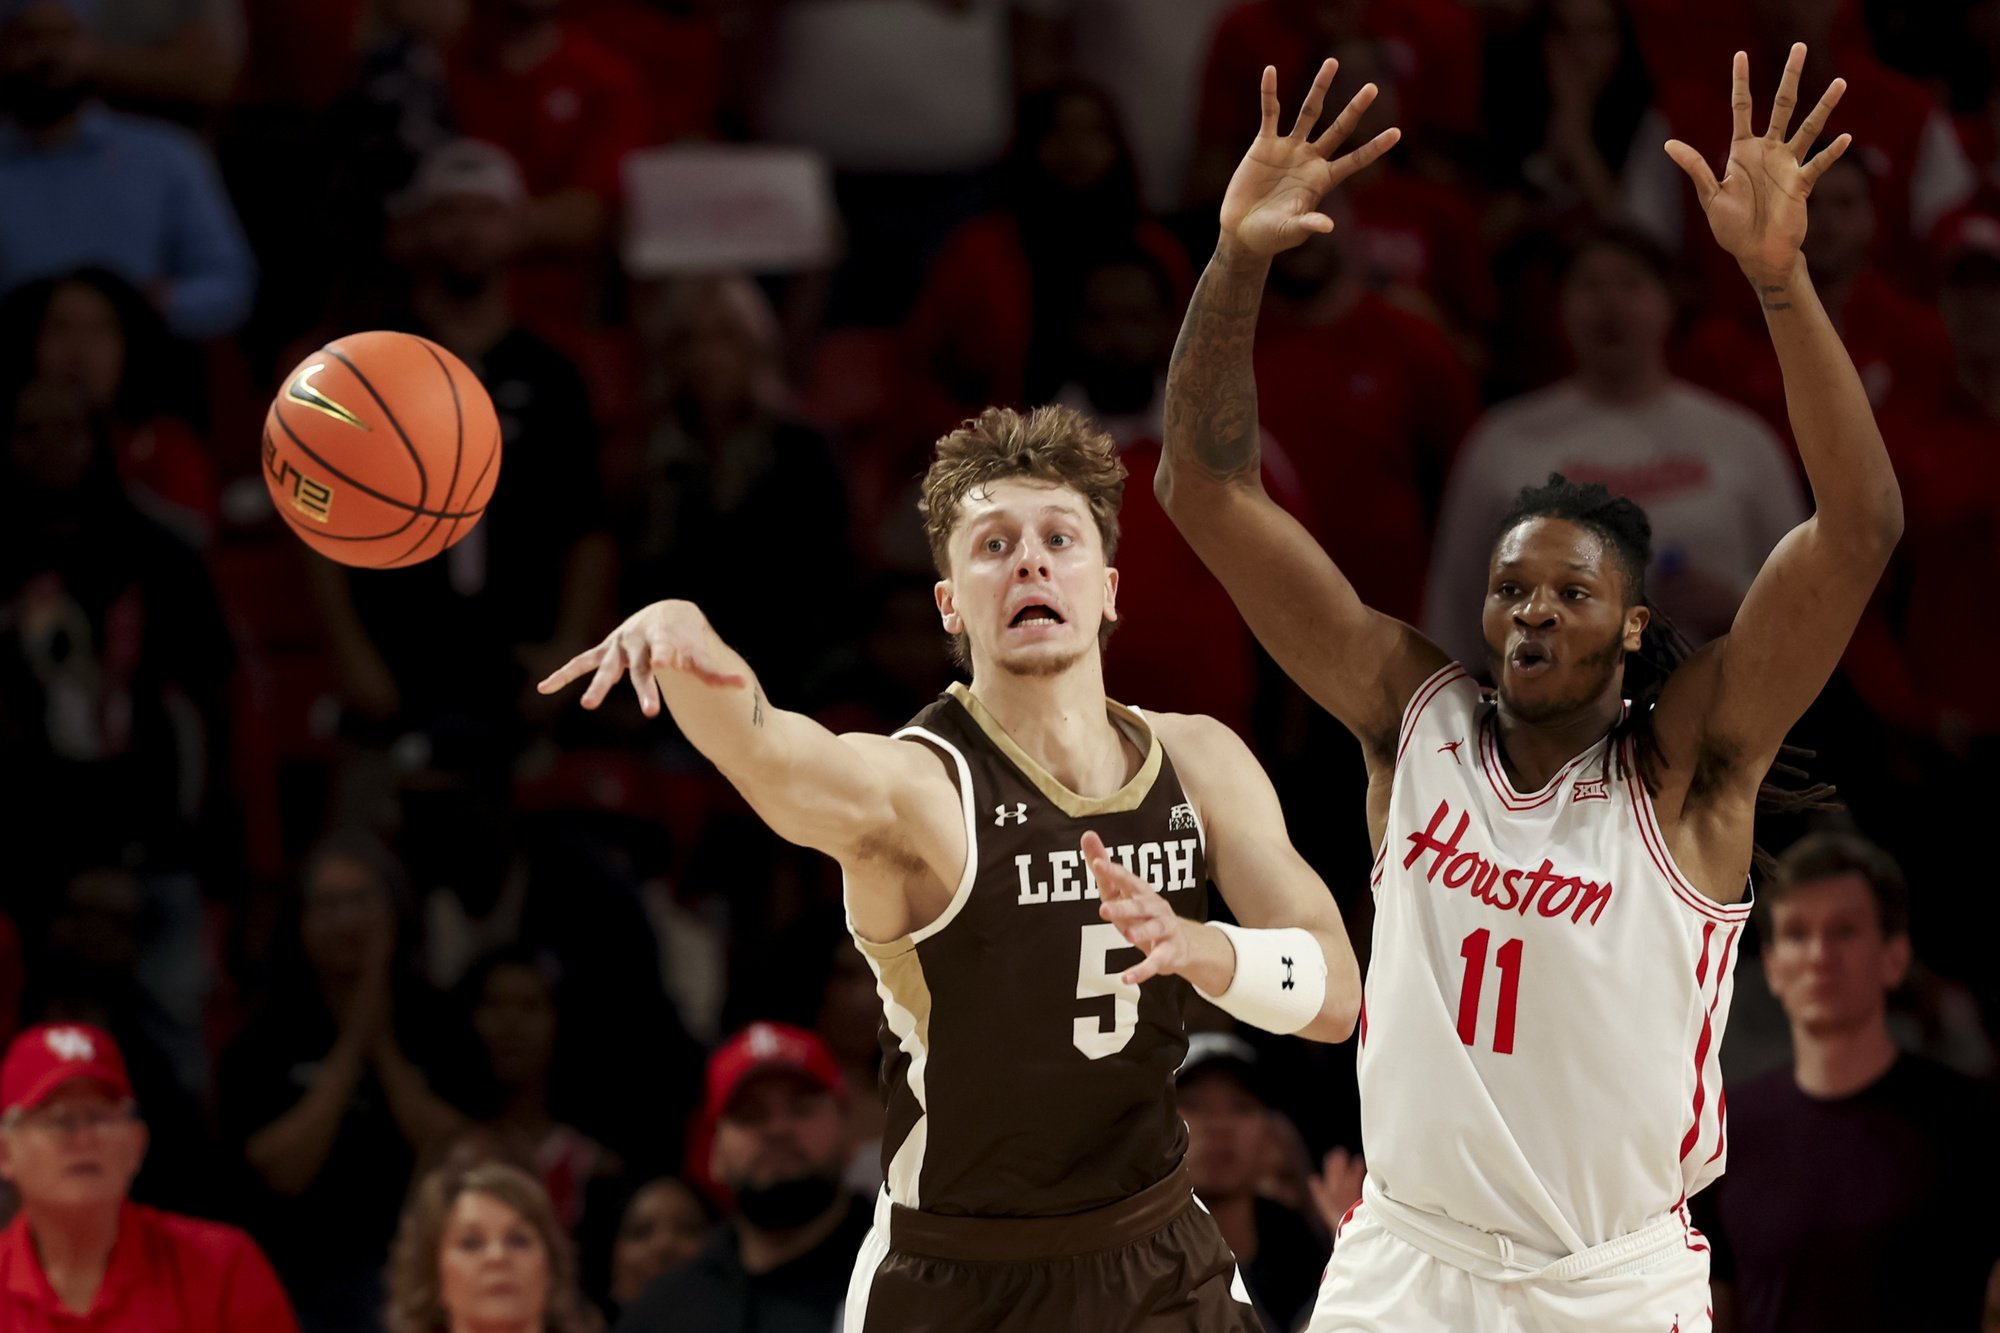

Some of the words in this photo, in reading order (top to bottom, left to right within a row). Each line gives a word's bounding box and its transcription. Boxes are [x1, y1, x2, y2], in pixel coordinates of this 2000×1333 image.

[1403, 799, 1613, 926] Houston
[1073, 922, 1141, 1060] 5
[1457, 927, 1523, 1055] 11
